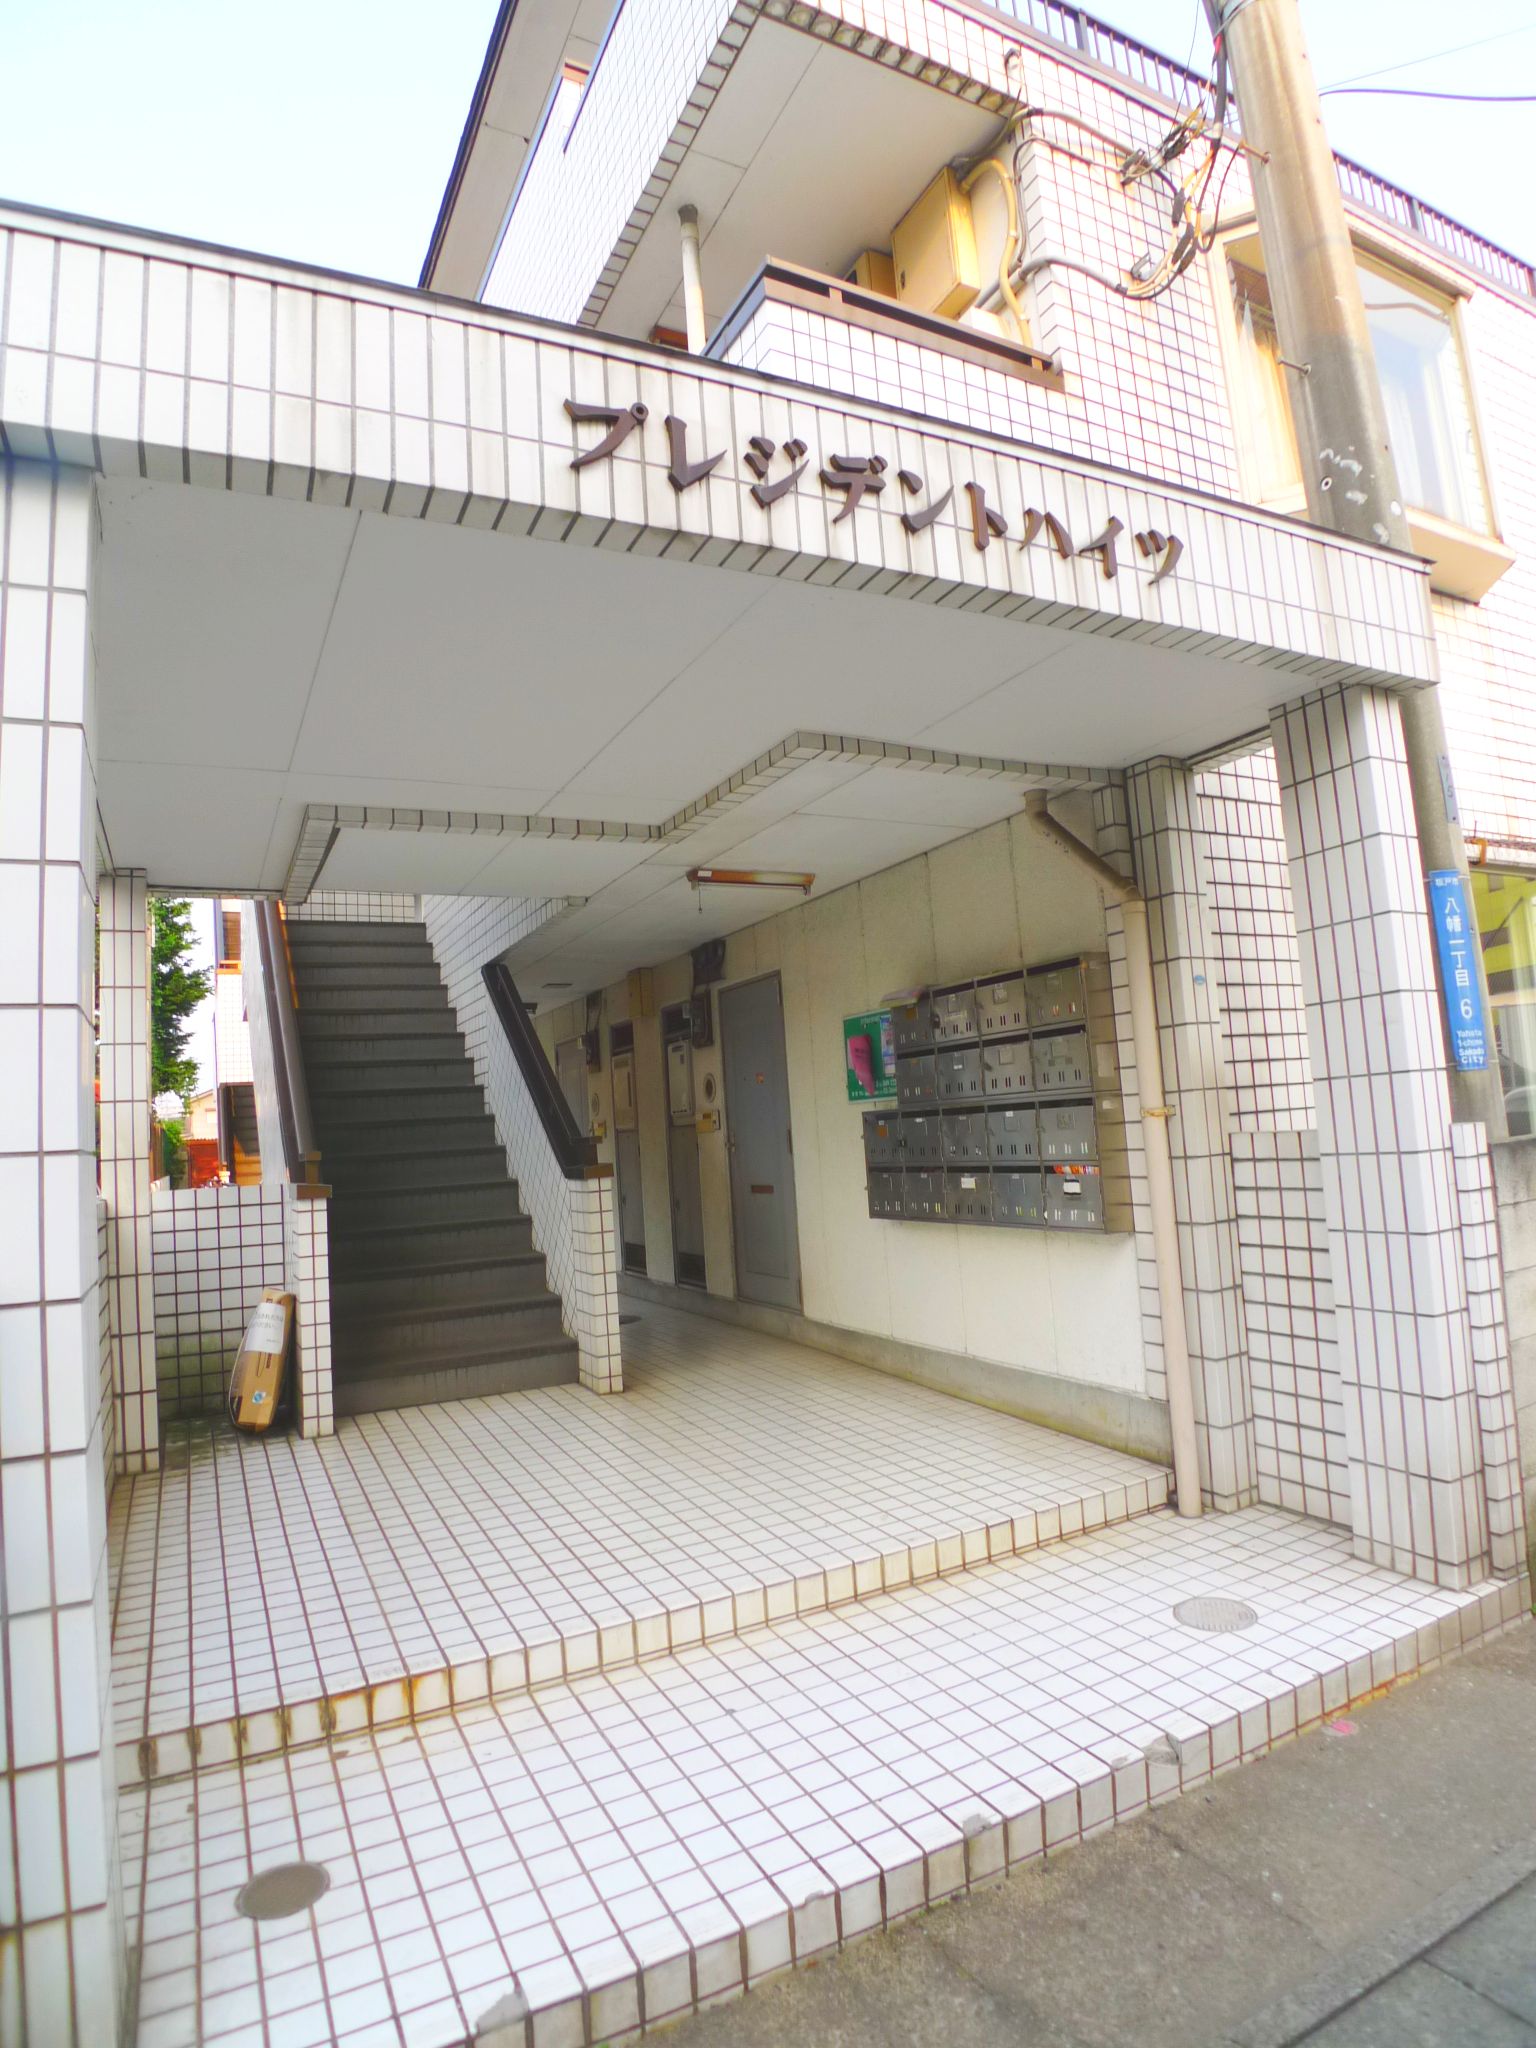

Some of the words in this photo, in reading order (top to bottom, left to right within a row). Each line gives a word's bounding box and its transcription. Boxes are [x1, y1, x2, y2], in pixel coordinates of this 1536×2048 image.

[563, 397, 1186, 587] プレジデントハイツ
[1444, 897, 1470, 986] 八幡一丁目
[1460, 998, 1473, 1020] 6
